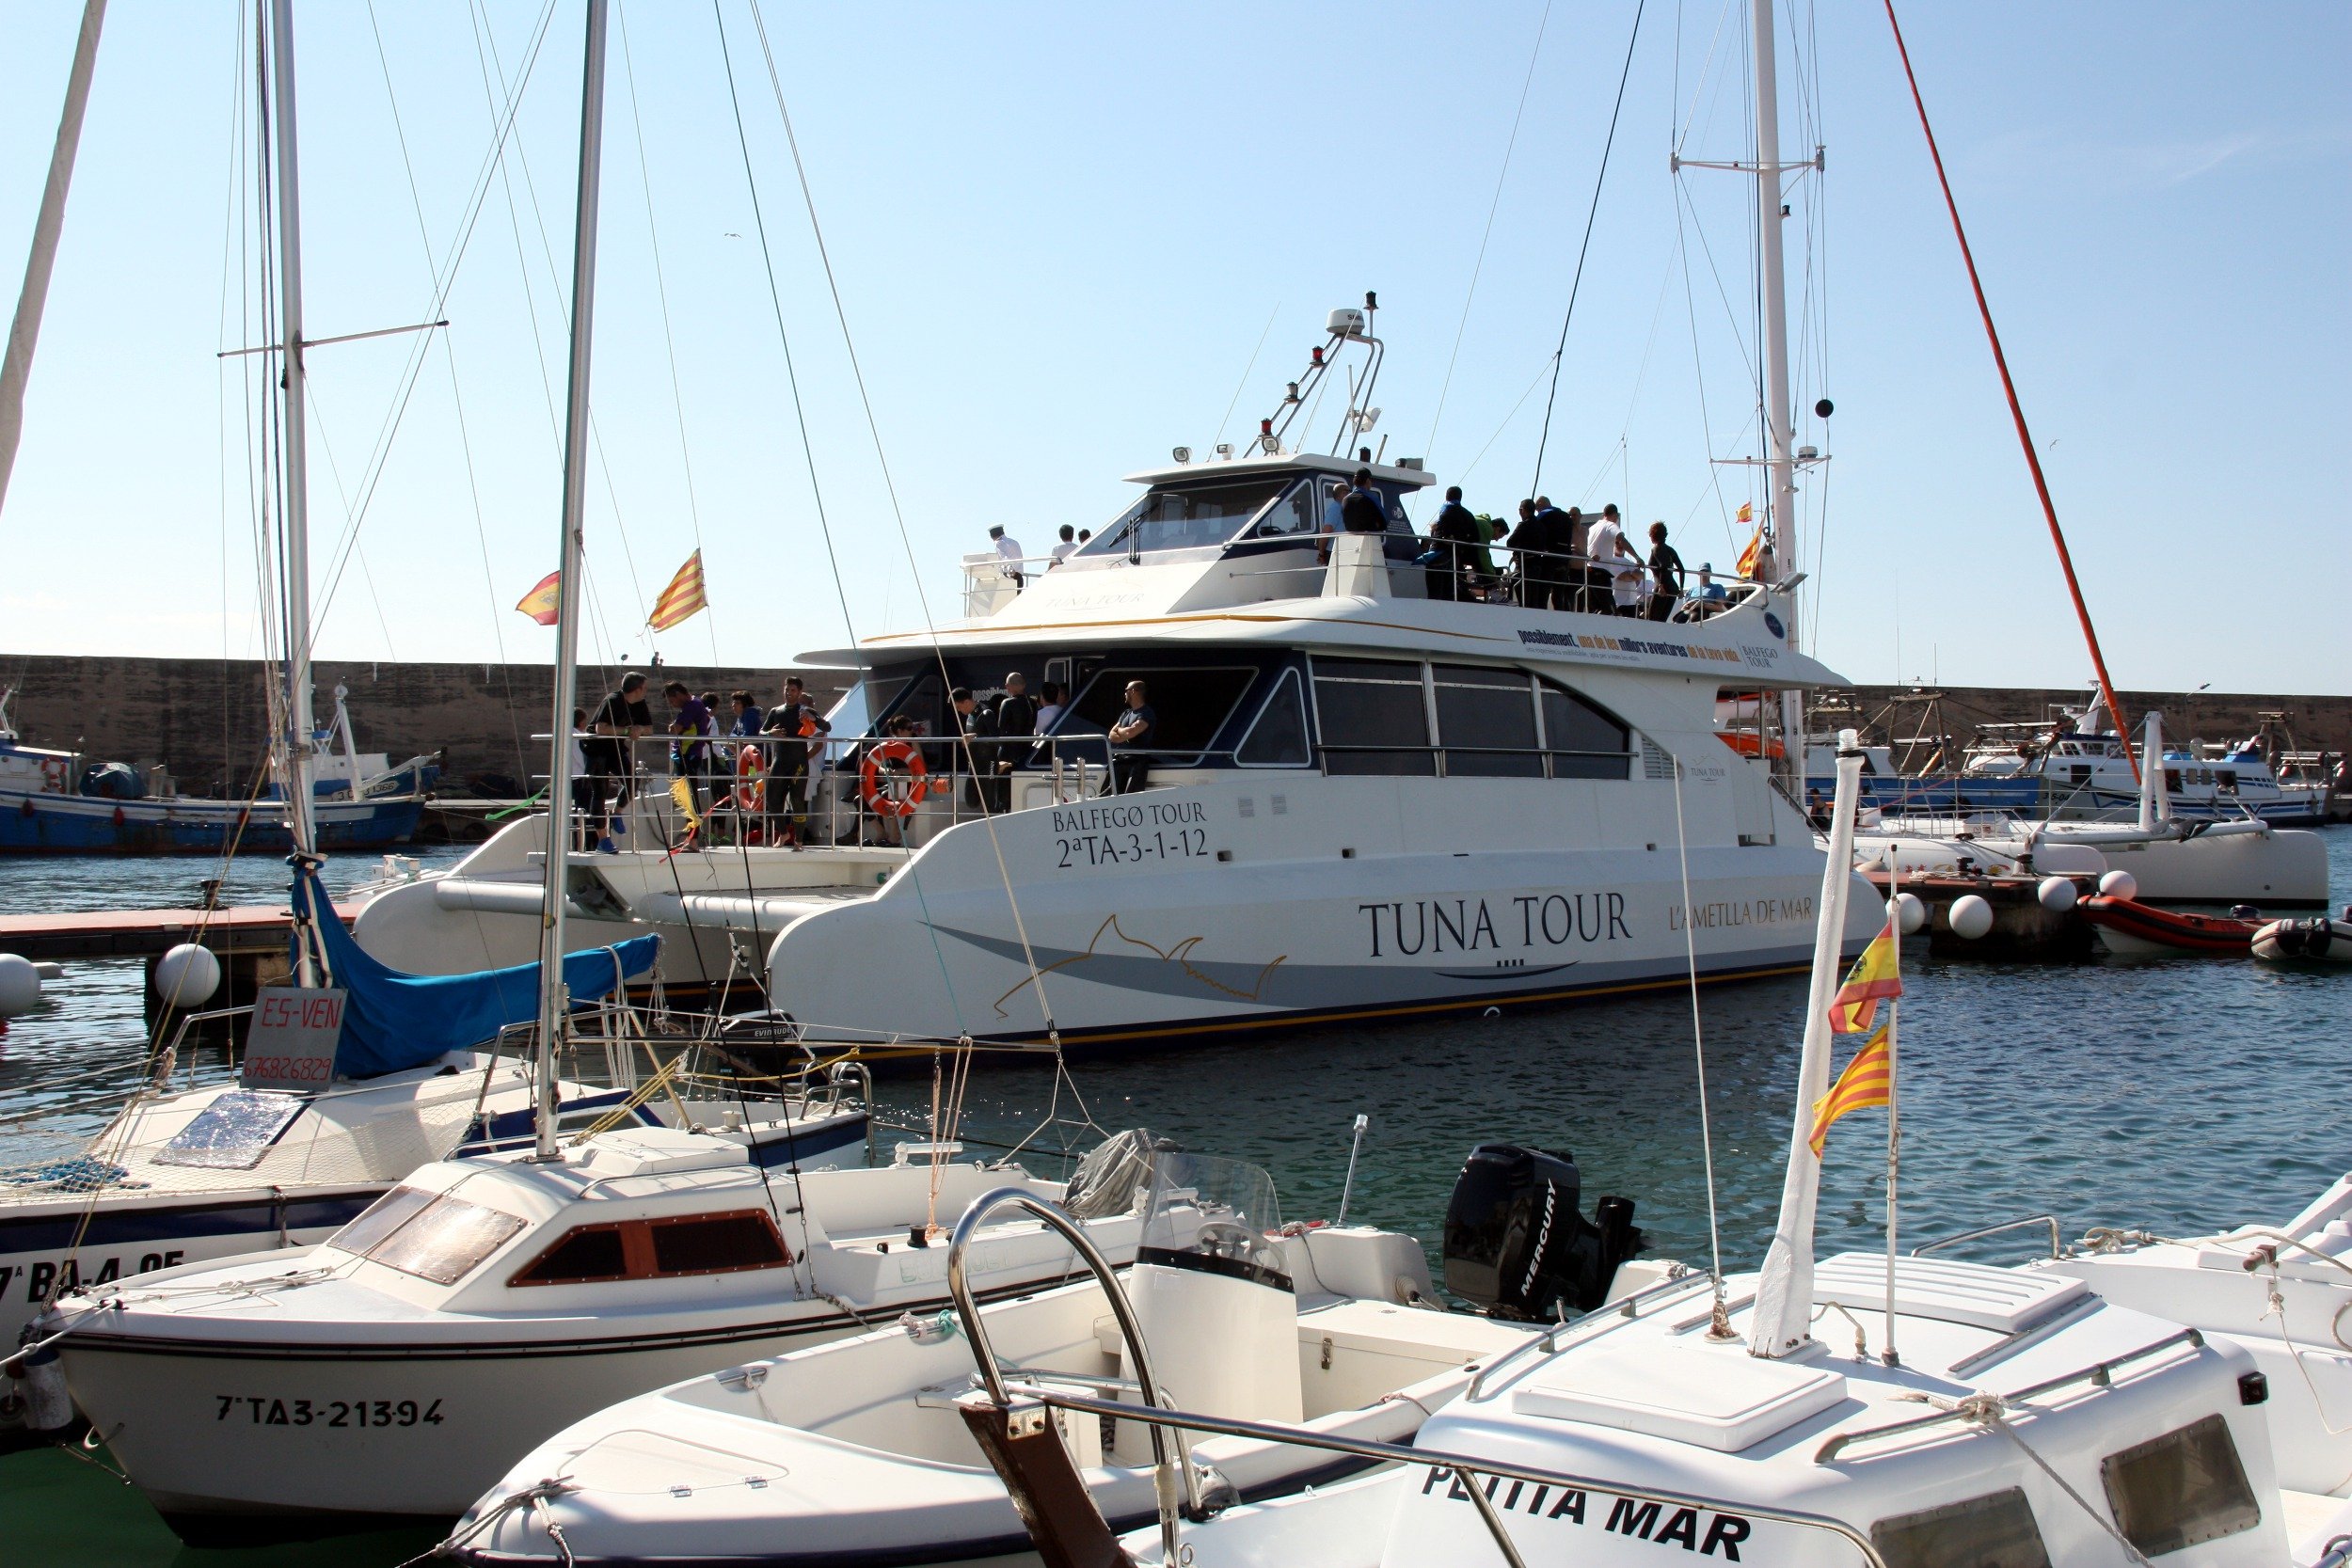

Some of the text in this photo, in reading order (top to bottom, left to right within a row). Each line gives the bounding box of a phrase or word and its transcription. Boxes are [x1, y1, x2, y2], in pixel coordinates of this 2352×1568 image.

[1646, 641, 1689, 658] aventures
[1686, 643, 1699, 659] de
[1696, 645, 1708, 661] la
[1746, 656, 1773, 669] TOUR
[1149, 801, 1208, 825] TOUR
[1756, 899, 1776, 924] DE
[1780, 896, 1813, 923] MAR
[1358, 892, 1633, 958] TUNA TOUR
[262, 997, 342, 1029] ES-VEN
[245, 1056, 332, 1081] 676826829
[1520, 1178, 1557, 1297] MERCURY
[1604, 1497, 1752, 1562] MAR
